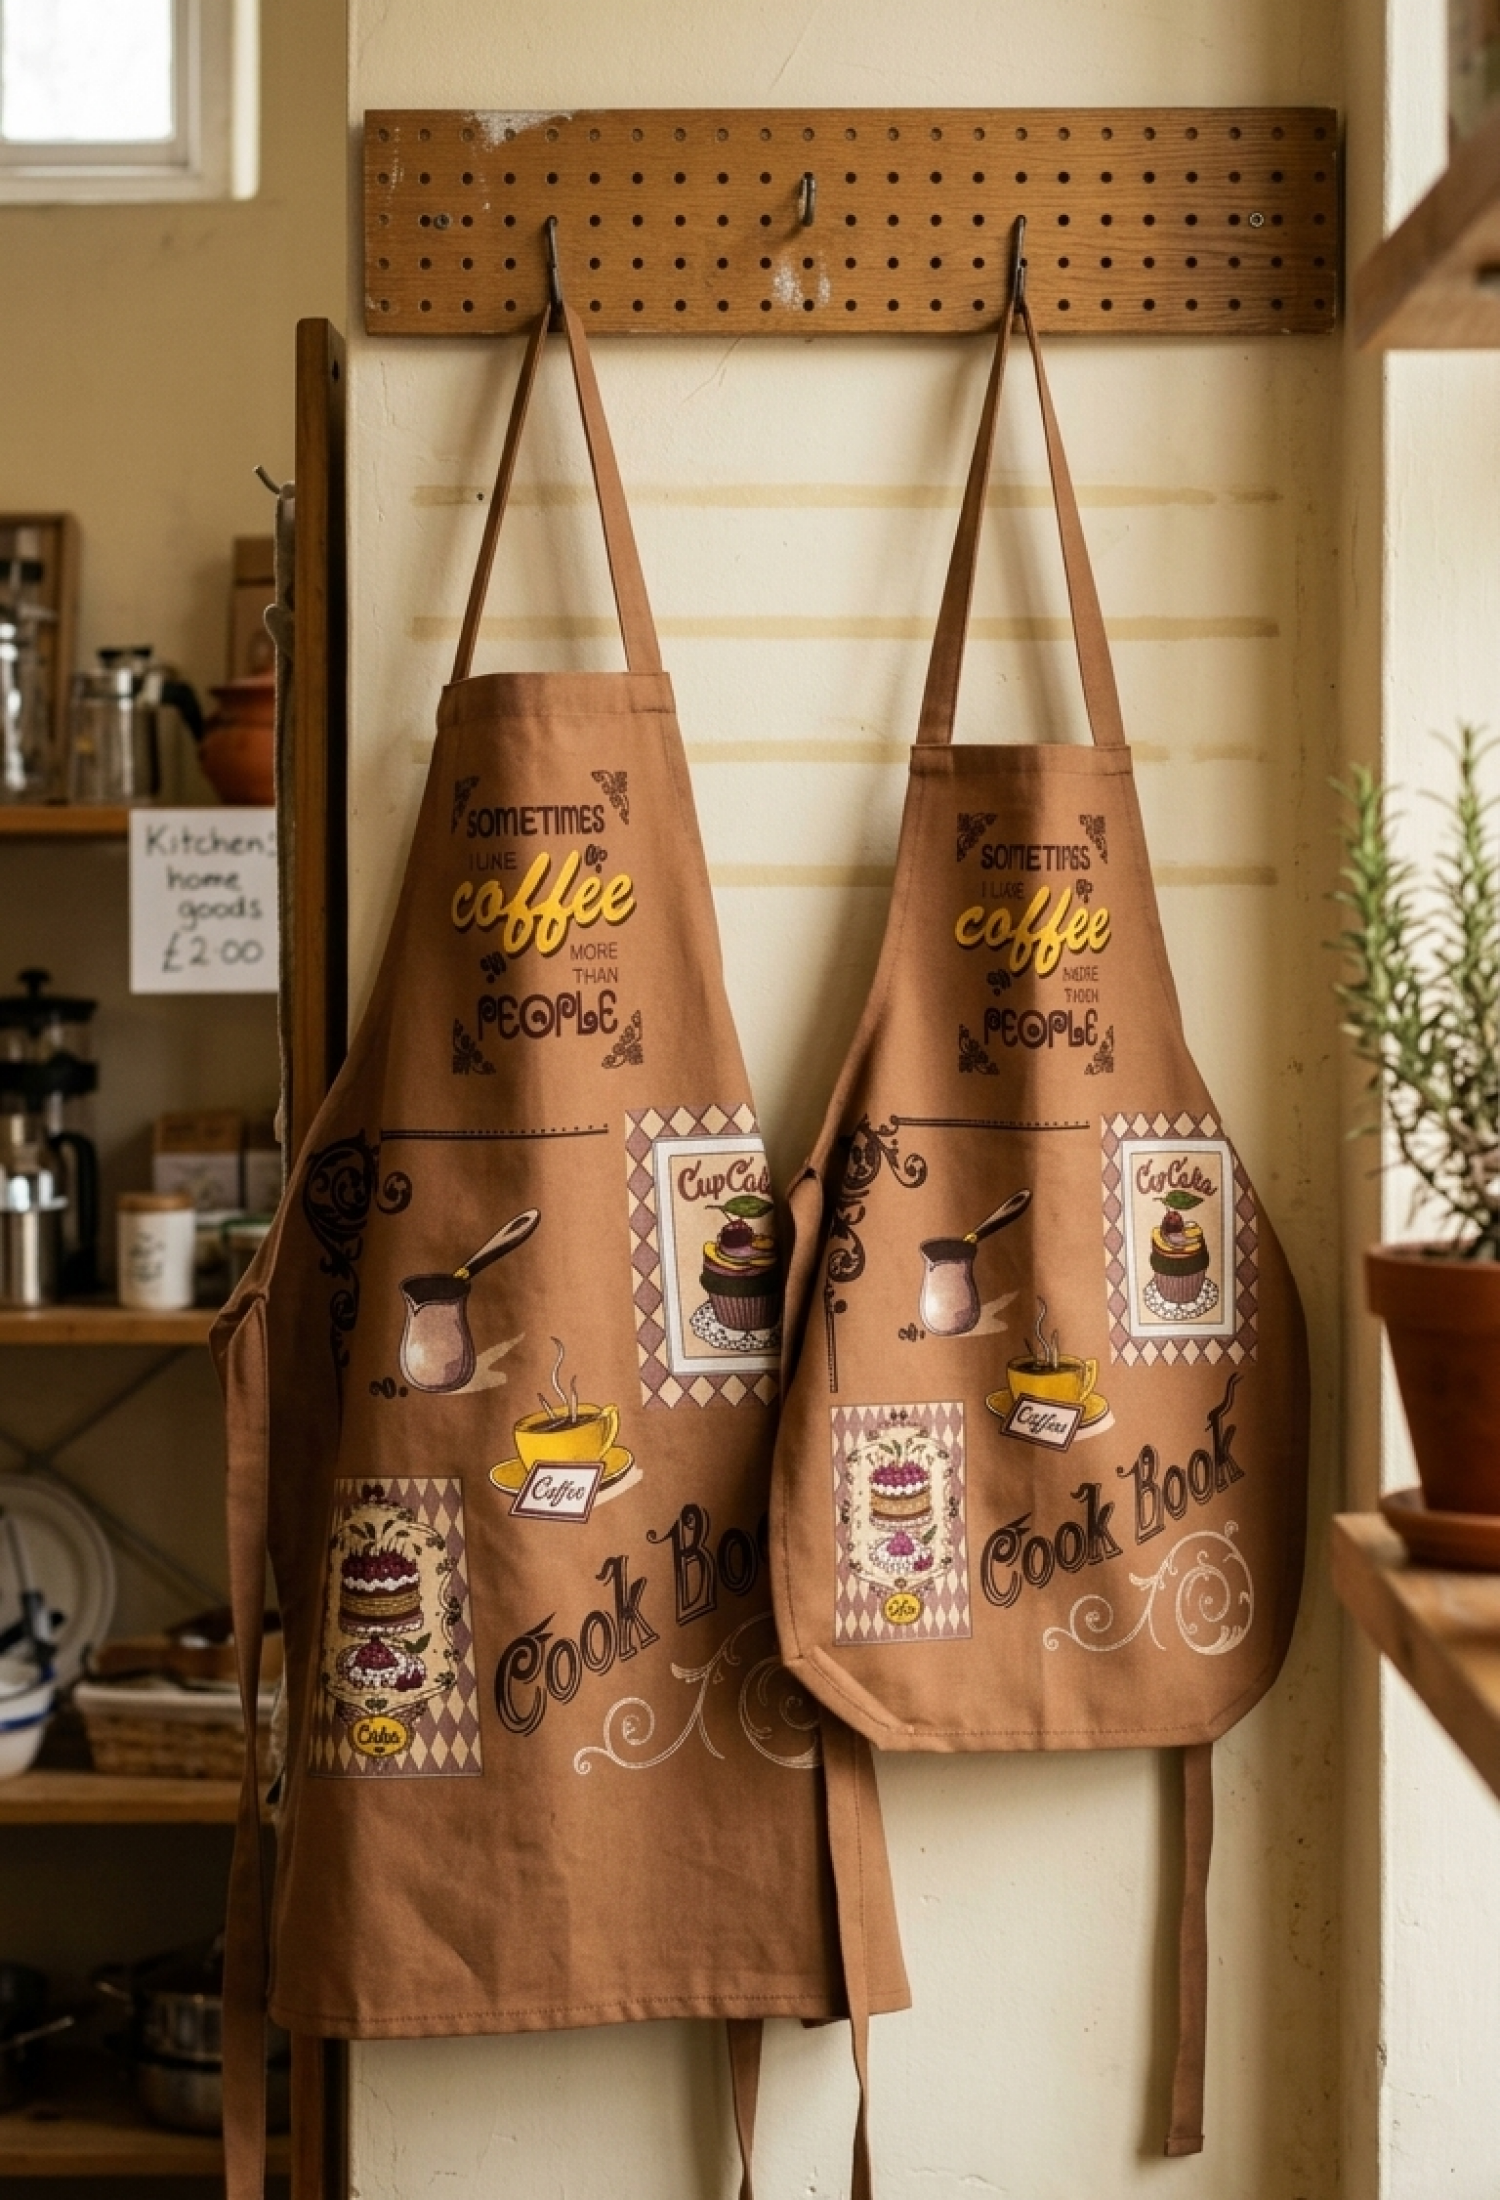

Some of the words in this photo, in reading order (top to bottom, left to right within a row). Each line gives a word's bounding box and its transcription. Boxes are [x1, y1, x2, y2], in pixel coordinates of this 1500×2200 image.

[466, 805, 605, 838] SOMETIMES
[167, 864, 241, 891] home
[178, 896, 263, 931] goods
[451, 850, 637, 958] coffee
[570, 942, 618, 961] MORE
[954, 885, 1112, 979] coffee
[572, 967, 619, 985] THAN
[477, 989, 618, 1042] PEOPLE
[983, 1008, 1099, 1050] PEOPLE
[979, 1482, 1124, 1608] Cook
[1115, 1372, 1246, 1547] Book
[494, 1555, 661, 1737] Cook
